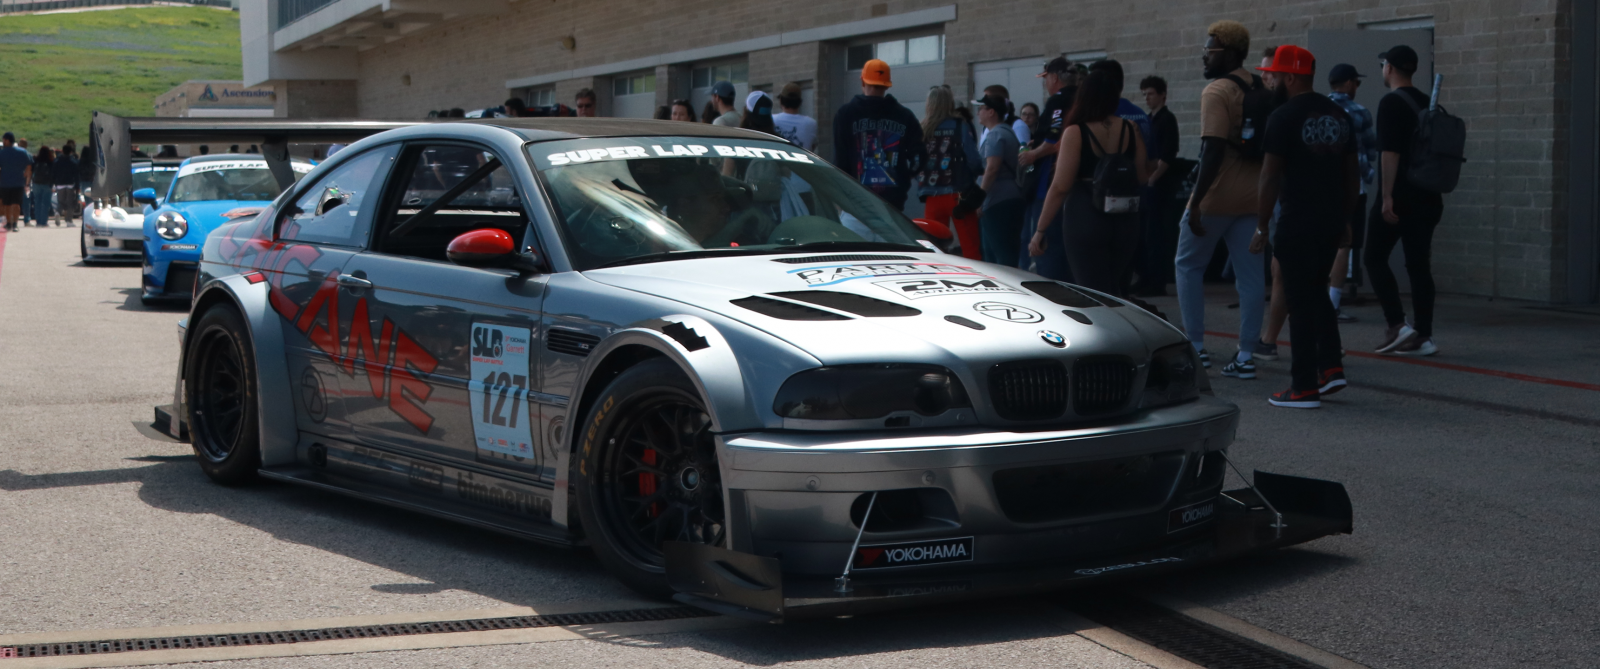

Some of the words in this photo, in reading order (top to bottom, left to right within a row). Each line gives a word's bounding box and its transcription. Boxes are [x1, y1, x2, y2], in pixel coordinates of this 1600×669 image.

[222, 88, 274, 97] Ascension
[547, 145, 650, 166] SUPER
[651, 144, 709, 157] LAP
[713, 145, 815, 164] BATTLE
[194, 163, 235, 173] SUPER
[896, 279, 999, 293] 2M
[482, 370, 527, 429] 127
[583, 395, 614, 457] ZERO
[457, 472, 554, 519] bimmerwo
[1181, 503, 1215, 524] YOKOHAMA
[884, 543, 969, 563] YOKOHAMA
